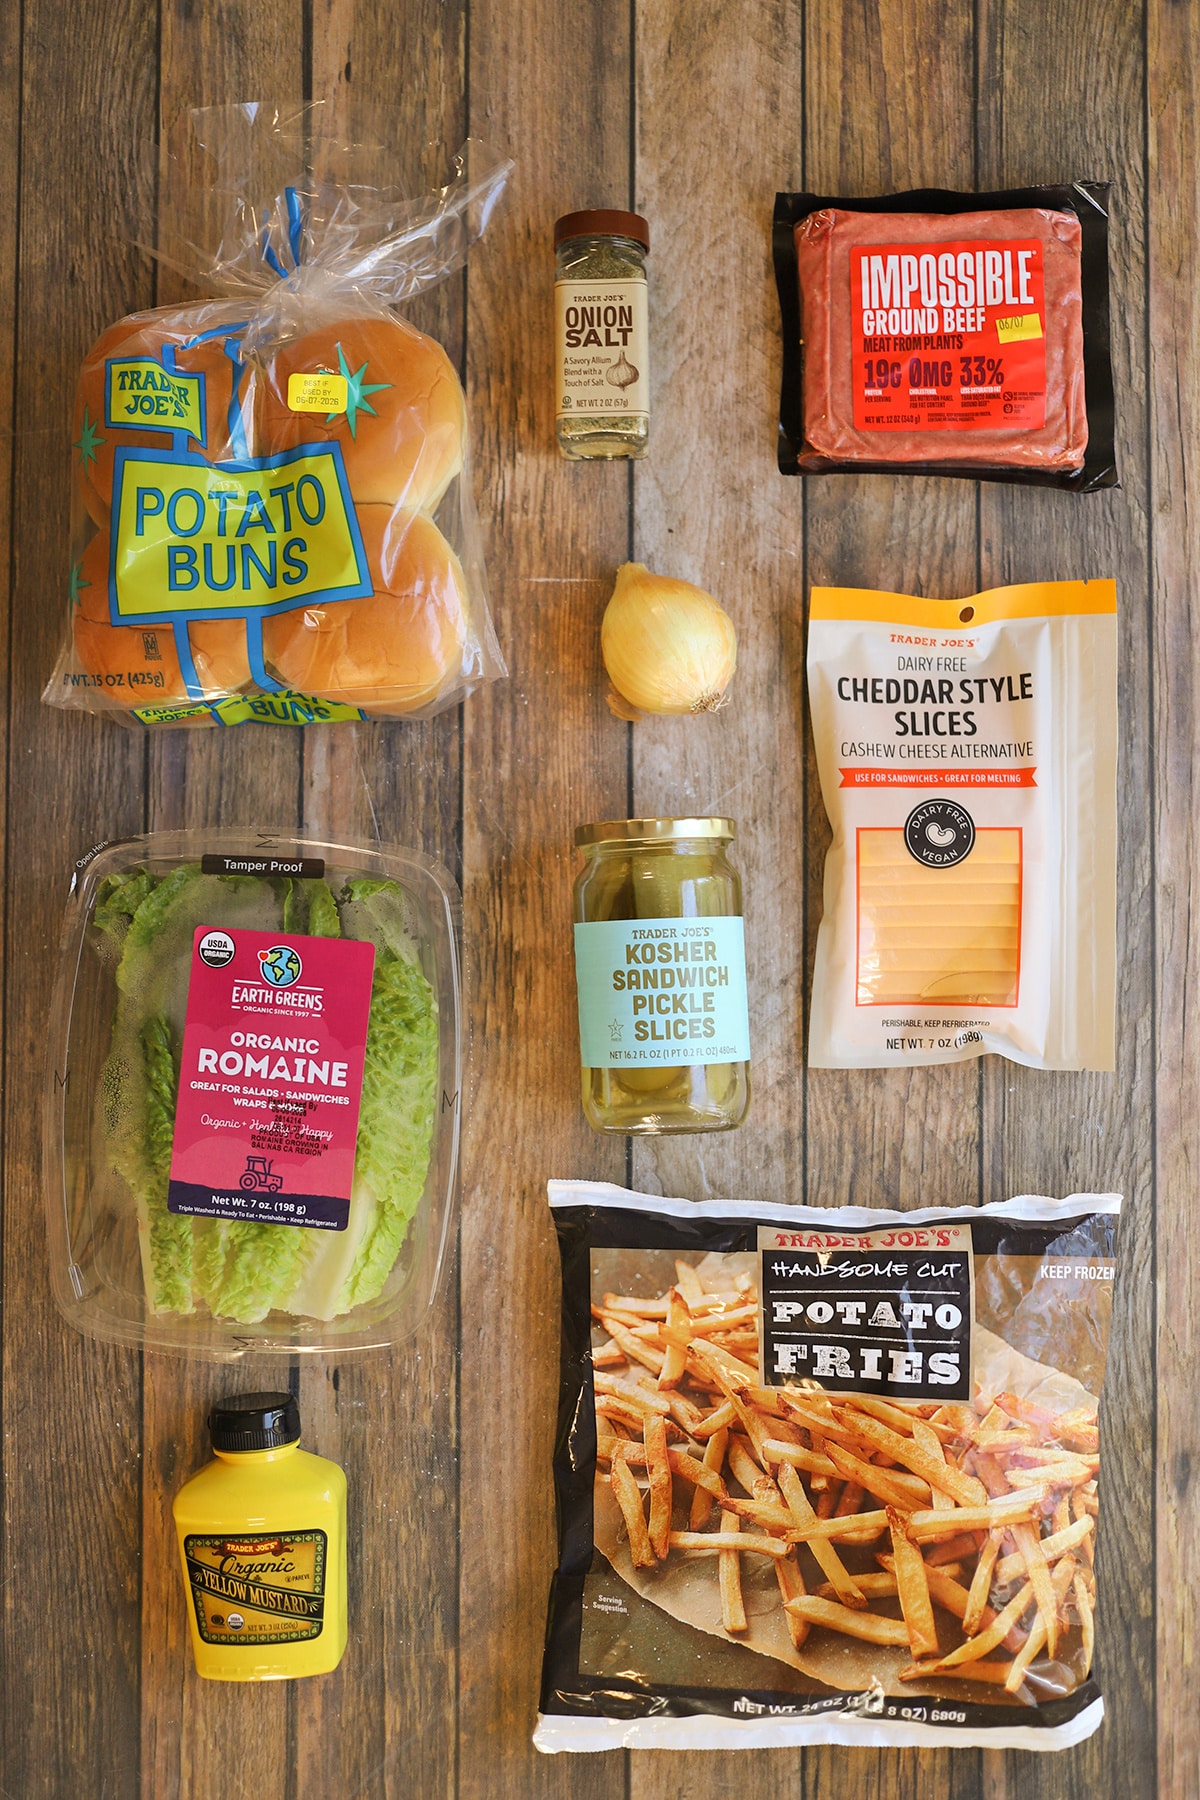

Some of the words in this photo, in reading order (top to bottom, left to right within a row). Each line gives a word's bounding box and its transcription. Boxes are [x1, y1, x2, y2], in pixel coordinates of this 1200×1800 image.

[860, 250, 1035, 310] IMPOSSIBLE
[573, 295, 602, 303] TRADER
[565, 305, 633, 331] ONION
[862, 308, 939, 336] GROUND
[943, 307, 986, 333] BEEF
[999, 316, 1023, 330] 06/07
[565, 327, 633, 348] SALT
[863, 337, 892, 353] MEAT
[893, 336, 923, 352] FROM
[924, 334, 963, 350] PLANTS
[563, 357, 569, 365] A
[569, 357, 591, 366] Savory
[591, 356, 612, 365] Allium
[563, 368, 582, 376] Blend
[582, 368, 597, 376] with
[864, 359, 902, 389] 19G
[959, 356, 1005, 387] 33%
[117, 370, 191, 407] TRADER
[583, 379, 590, 387] of
[591, 379, 604, 387] Salt
[296, 396, 339, 406] 06-07-2026
[322, 389, 332, 397] BY
[576, 399, 587, 408] NET
[599, 399, 604, 407] 2
[604, 399, 613, 407] OZ
[864, 416, 875, 424] NET
[875, 415, 886, 424] WT.
[886, 415, 893, 423] 12
[893, 415, 900, 423] OZ
[135, 473, 326, 538] POTATO
[167, 537, 309, 592] BUNS
[890, 633, 937, 647] TRADER
[897, 656, 934, 672] DAIRY
[936, 656, 967, 672] FREE
[92, 673, 103, 687] 15
[105, 673, 125, 687] OZ
[128, 671, 165, 689] (425g)
[837, 676, 954, 705] CHEDDAR
[959, 672, 1034, 704] STYLE
[248, 699, 331, 722] BUNS
[895, 710, 978, 737] SLICES
[840, 741, 896, 759] CASHEW
[899, 743, 948, 760] CHEESE
[951, 741, 1034, 759] ALTERNATIVE
[854, 773, 870, 783] USE
[871, 773, 886, 783] FOR
[887, 773, 939, 783] SANDWICHES
[944, 773, 970, 783] GREAT
[970, 773, 986, 783] FOR
[987, 773, 1021, 783] MELTING
[911, 804, 943, 829] DAIRY
[946, 806, 969, 830] FREE
[75, 851, 95, 868] Open
[92, 840, 109, 854] Here
[922, 848, 959, 863] VEGAN
[223, 859, 268, 873] Tamper
[270, 861, 303, 873] Proof
[632, 927, 677, 940] TRADER
[207, 939, 228, 949] USDA
[625, 941, 717, 965] KOSHER
[203, 949, 230, 959] ORGANIC
[612, 965, 729, 991] SANDWICH
[231, 986, 273, 1005] EARTH
[275, 989, 323, 1012] GREENS
[632, 992, 716, 1016] PICKLE
[242, 1005, 274, 1015] ORGANIC
[274, 1008, 294, 1017] SINCE
[294, 1010, 310, 1018] 1997
[634, 1017, 716, 1042] SLICES
[881, 1019, 923, 1028] PERISHABLE,
[923, 1019, 941, 1028] KEEP
[230, 1031, 320, 1055] ORGANIC
[886, 1038, 905, 1050] NET
[907, 1038, 926, 1050] WT.
[928, 1038, 935, 1049] 7
[937, 1038, 951, 1049] OZ
[954, 1030, 984, 1049] (198g)
[609, 1050, 622, 1060] NET
[623, 1050, 637, 1060] 16.2
[639, 1050, 648, 1059] FL
[649, 1049, 661, 1059] OZ
[663, 1049, 670, 1060] (1
[671, 1048, 681, 1058] PT
[683, 1047, 695, 1058] 0.2
[696, 1047, 704, 1057] FL
[705, 1046, 718, 1057] OZ)
[197, 1048, 349, 1088] ROMAINE
[190, 1080, 221, 1092] GREAT
[221, 1083, 241, 1094] FOR
[242, 1085, 279, 1098] SALADS
[285, 1090, 350, 1106] SANDWICHES
[233, 1097, 267, 1109] WRAPS
[308, 1101, 318, 1112] By
[200, 1113, 241, 1130] Organic
[299, 1123, 334, 1142] Happy
[251, 1134, 284, 1145] ROMAINE
[285, 1138, 319, 1149] GROWING
[305, 1134, 322, 1143] USA
[283, 1145, 294, 1153] CA
[294, 1147, 323, 1157] REGION
[211, 1195, 230, 1206] Net
[231, 1197, 249, 1208] Wt.
[250, 1199, 257, 1208] 7
[258, 1201, 272, 1210] oz.
[274, 1201, 295, 1212] (198
[296, 1204, 307, 1216] g)
[178, 1204, 194, 1212] Triple
[193, 1206, 216, 1215] Washed
[220, 1209, 238, 1218] Ready
[245, 1211, 255, 1219] Eat
[258, 1213, 287, 1222] Perishable
[289, 1216, 305, 1225] Keep
[304, 1218, 338, 1228] Refrigerated
[774, 1231, 872, 1250] TRADER
[771, 1261, 908, 1279] HANDSOME
[916, 1262, 962, 1280] CUT
[1040, 1264, 1072, 1279] KEEP
[772, 1301, 963, 1331] POTATO
[773, 1343, 962, 1385] FRIES
[226, 1543, 254, 1553] TRADER
[219, 1554, 296, 1582] Organic
[202, 1568, 247, 1602] YELLOW
[248, 1585, 309, 1616] MUSTARD
[598, 1594, 623, 1606] Serving
[592, 1601, 628, 1614] Suggestion
[732, 1697, 766, 1715] NET
[768, 1704, 798, 1715] WT.
[801, 1703, 819, 1714] 24
[822, 1697, 844, 1708] OZ
[887, 1705, 897, 1717] 8
[901, 1707, 928, 1722] OZ)
[930, 1708, 967, 1723] 680g
